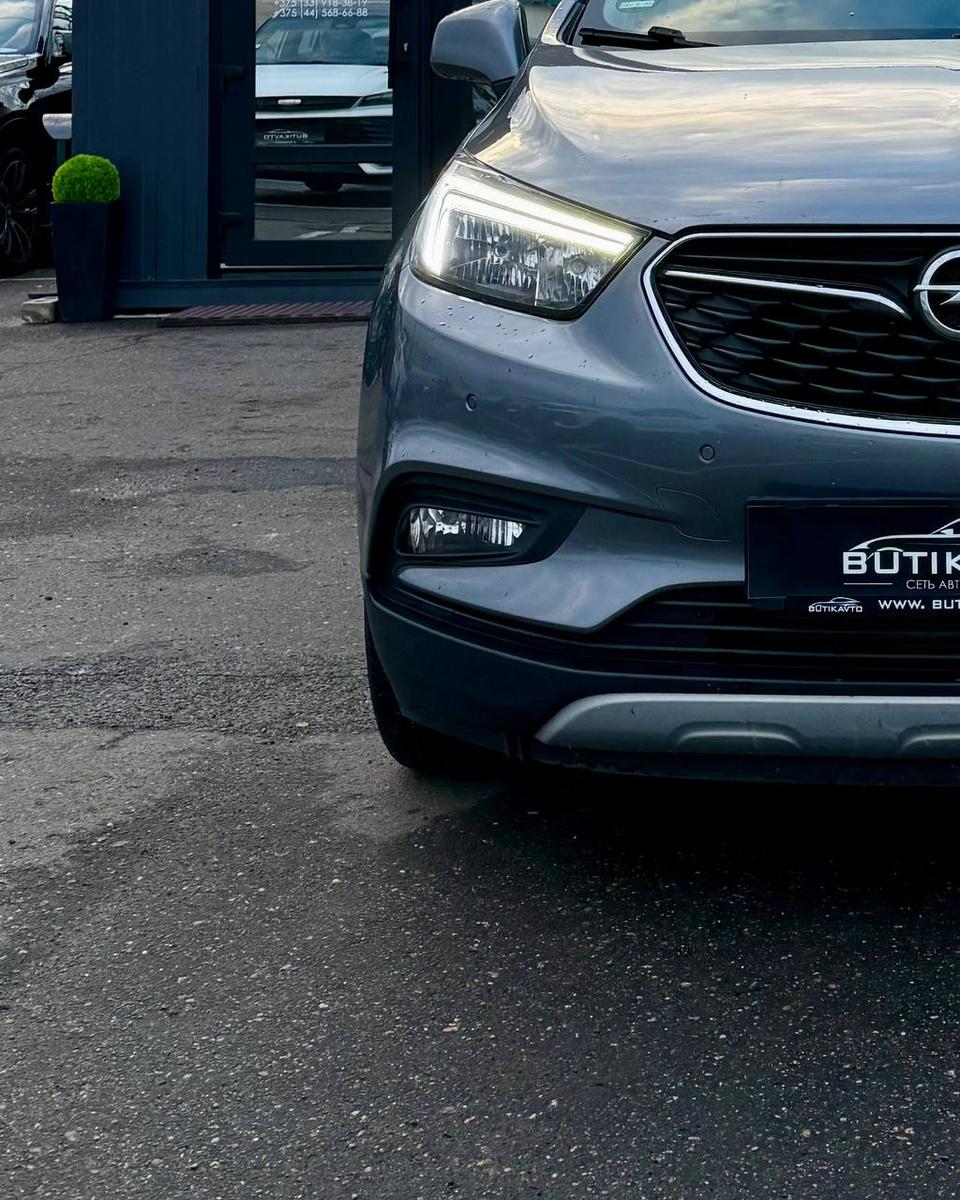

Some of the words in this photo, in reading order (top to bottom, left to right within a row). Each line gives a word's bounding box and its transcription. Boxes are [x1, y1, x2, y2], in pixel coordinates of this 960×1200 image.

[300, 7, 318, 19] (44)
[321, 8, 369, 17] 568-66-88
[906, 579, 935, 590] СЕТЬ
[808, 604, 863, 613] BUTIKAVTO
[878, 599, 926, 610] WWW.
